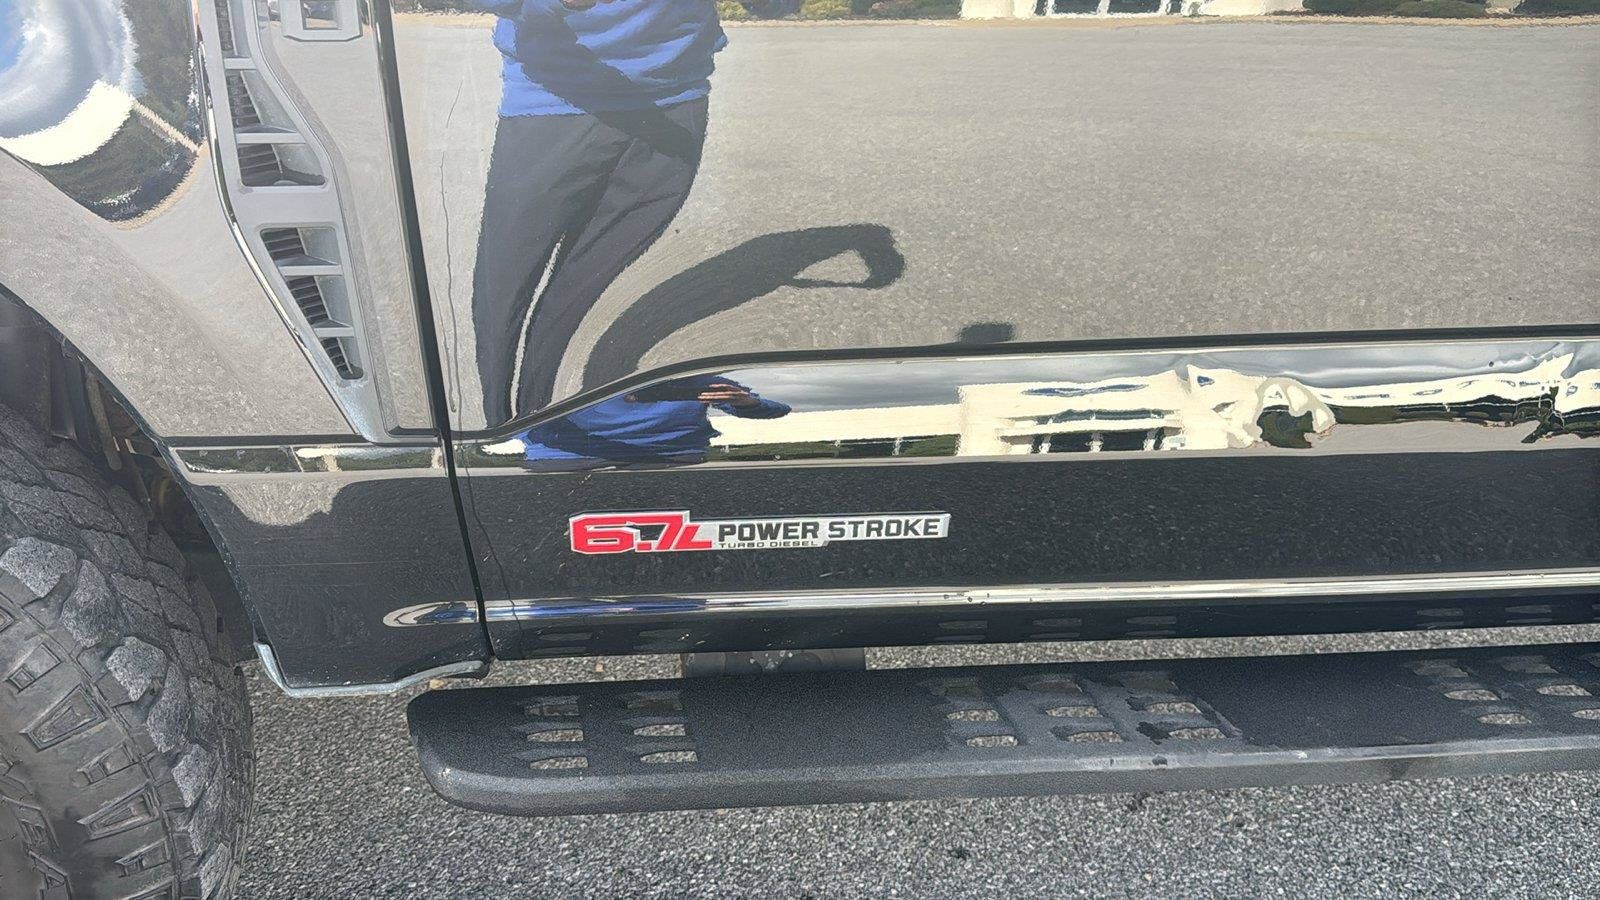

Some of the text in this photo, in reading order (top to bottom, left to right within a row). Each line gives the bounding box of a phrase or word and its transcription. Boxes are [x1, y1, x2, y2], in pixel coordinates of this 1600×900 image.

[572, 513, 941, 552] 6.7L POWER STROKE
[719, 540, 818, 549] TURBO DIESEL
